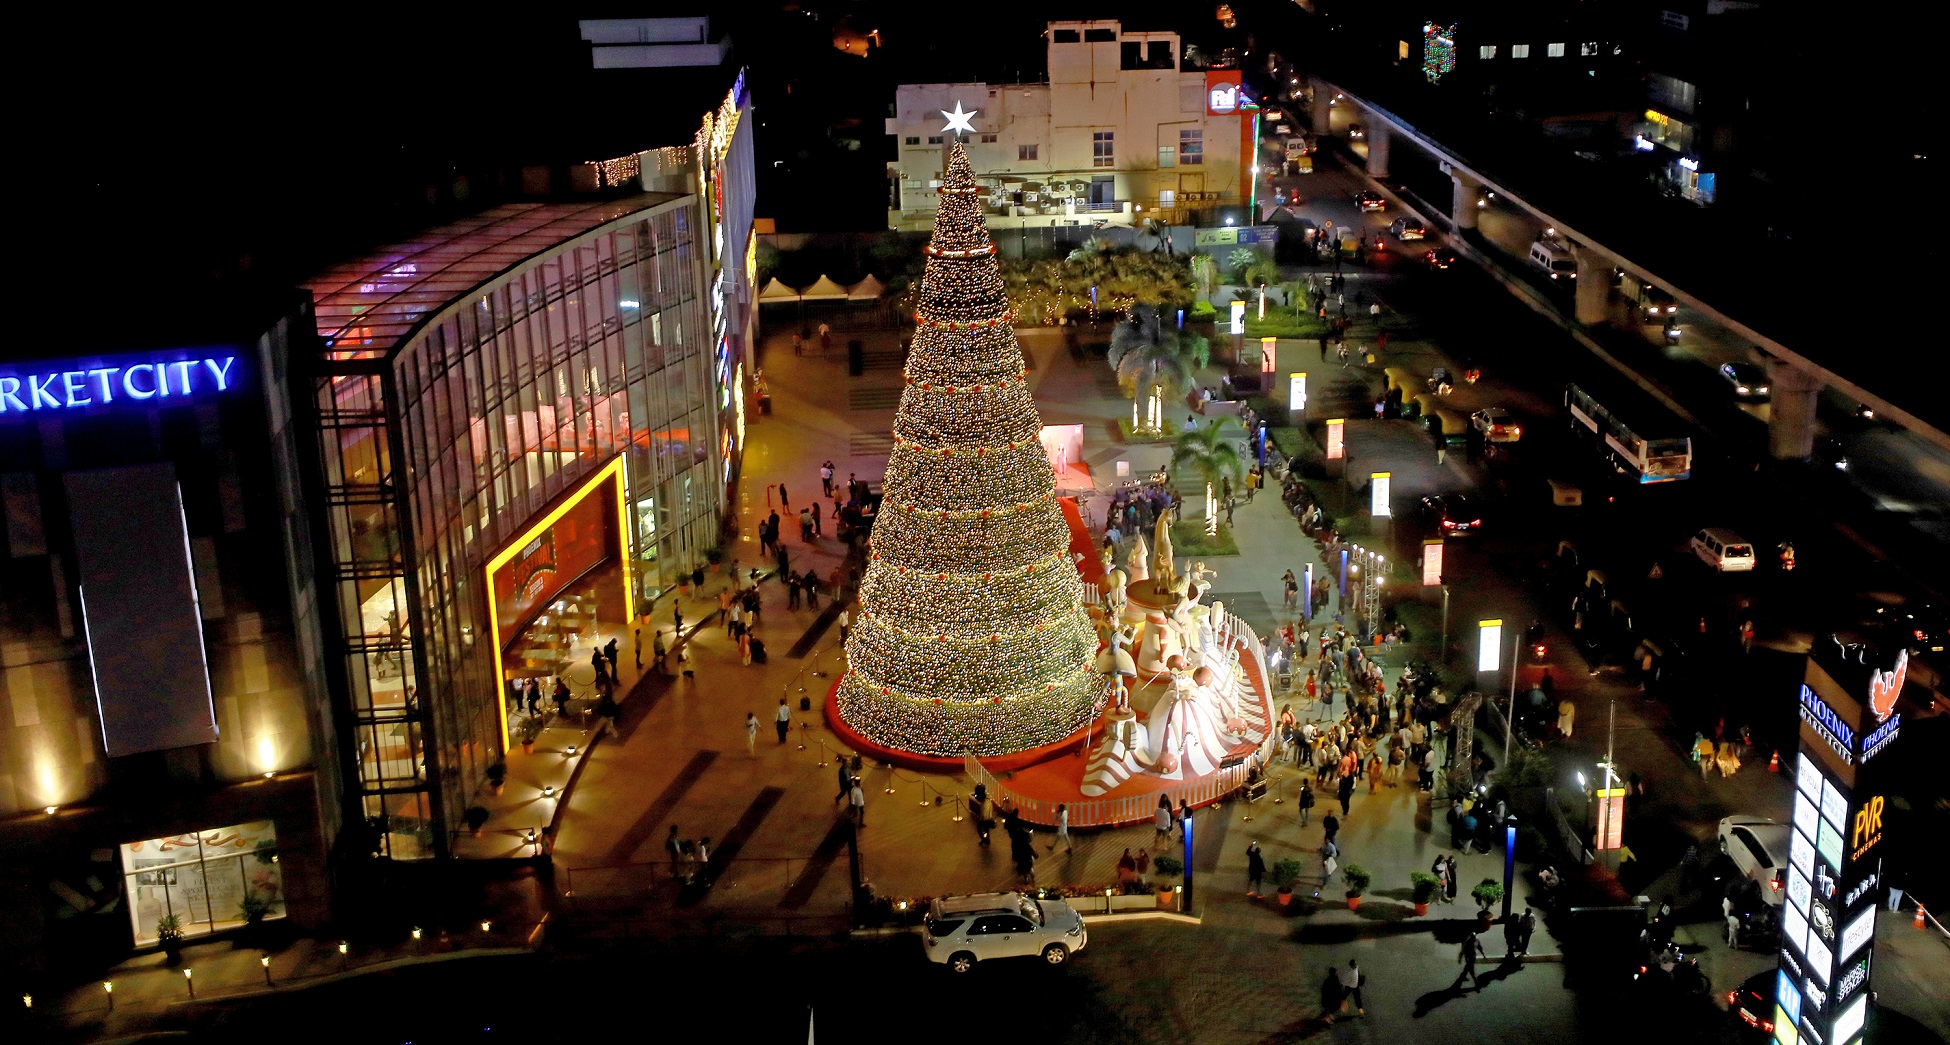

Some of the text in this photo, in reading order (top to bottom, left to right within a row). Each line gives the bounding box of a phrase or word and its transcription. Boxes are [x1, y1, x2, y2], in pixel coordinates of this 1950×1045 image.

[0, 356, 235, 412] RKETCITY
[1800, 684, 1854, 750] PHOENIX
[1862, 713, 1901, 751] PHOENIX
[1800, 706, 1853, 767] MARKETCITY
[1852, 795, 1885, 849] PVR
[1852, 832, 1882, 863] CINEMAS
[1846, 873, 1877, 908] ZARA
[1843, 915, 1872, 951] lifestyle
[1838, 969, 1866, 1003] SPENCER
[1840, 962, 1862, 989] MARKS
[1780, 979, 1798, 1015] GAP
